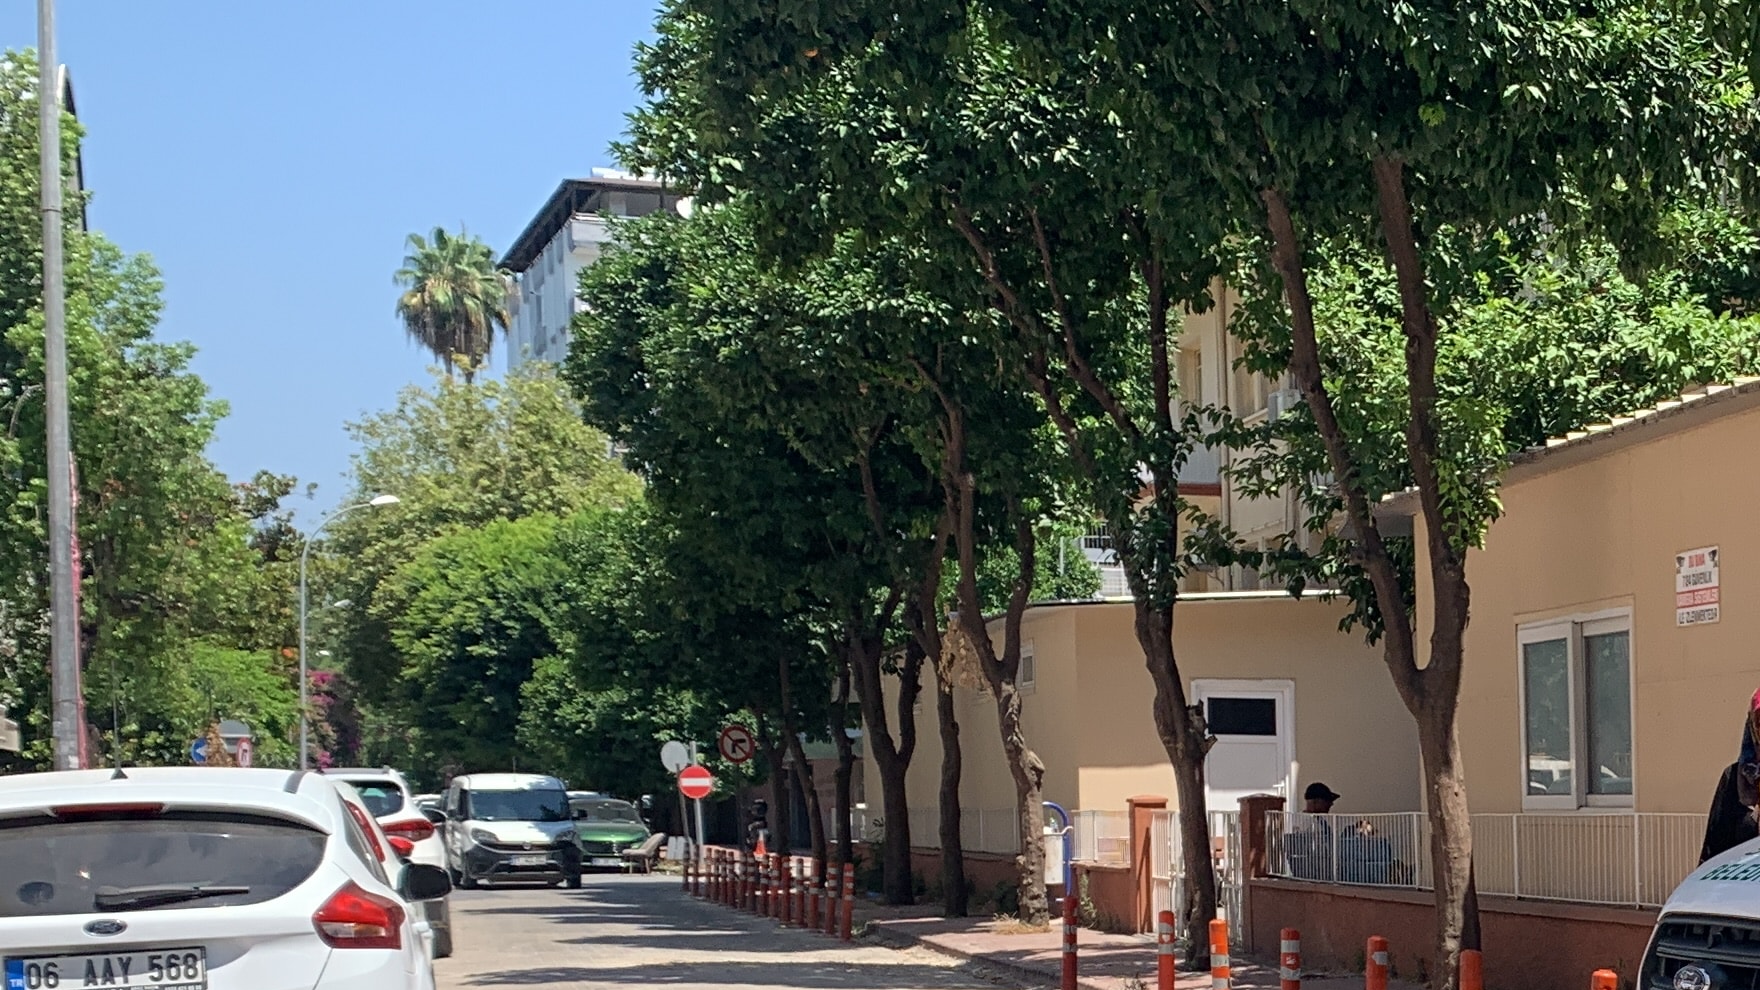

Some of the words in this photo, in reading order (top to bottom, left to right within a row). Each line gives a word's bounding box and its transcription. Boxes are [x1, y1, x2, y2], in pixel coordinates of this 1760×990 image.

[25, 962, 60, 990] 06
[83, 956, 133, 987] AAY
[148, 953, 199, 982] 568
